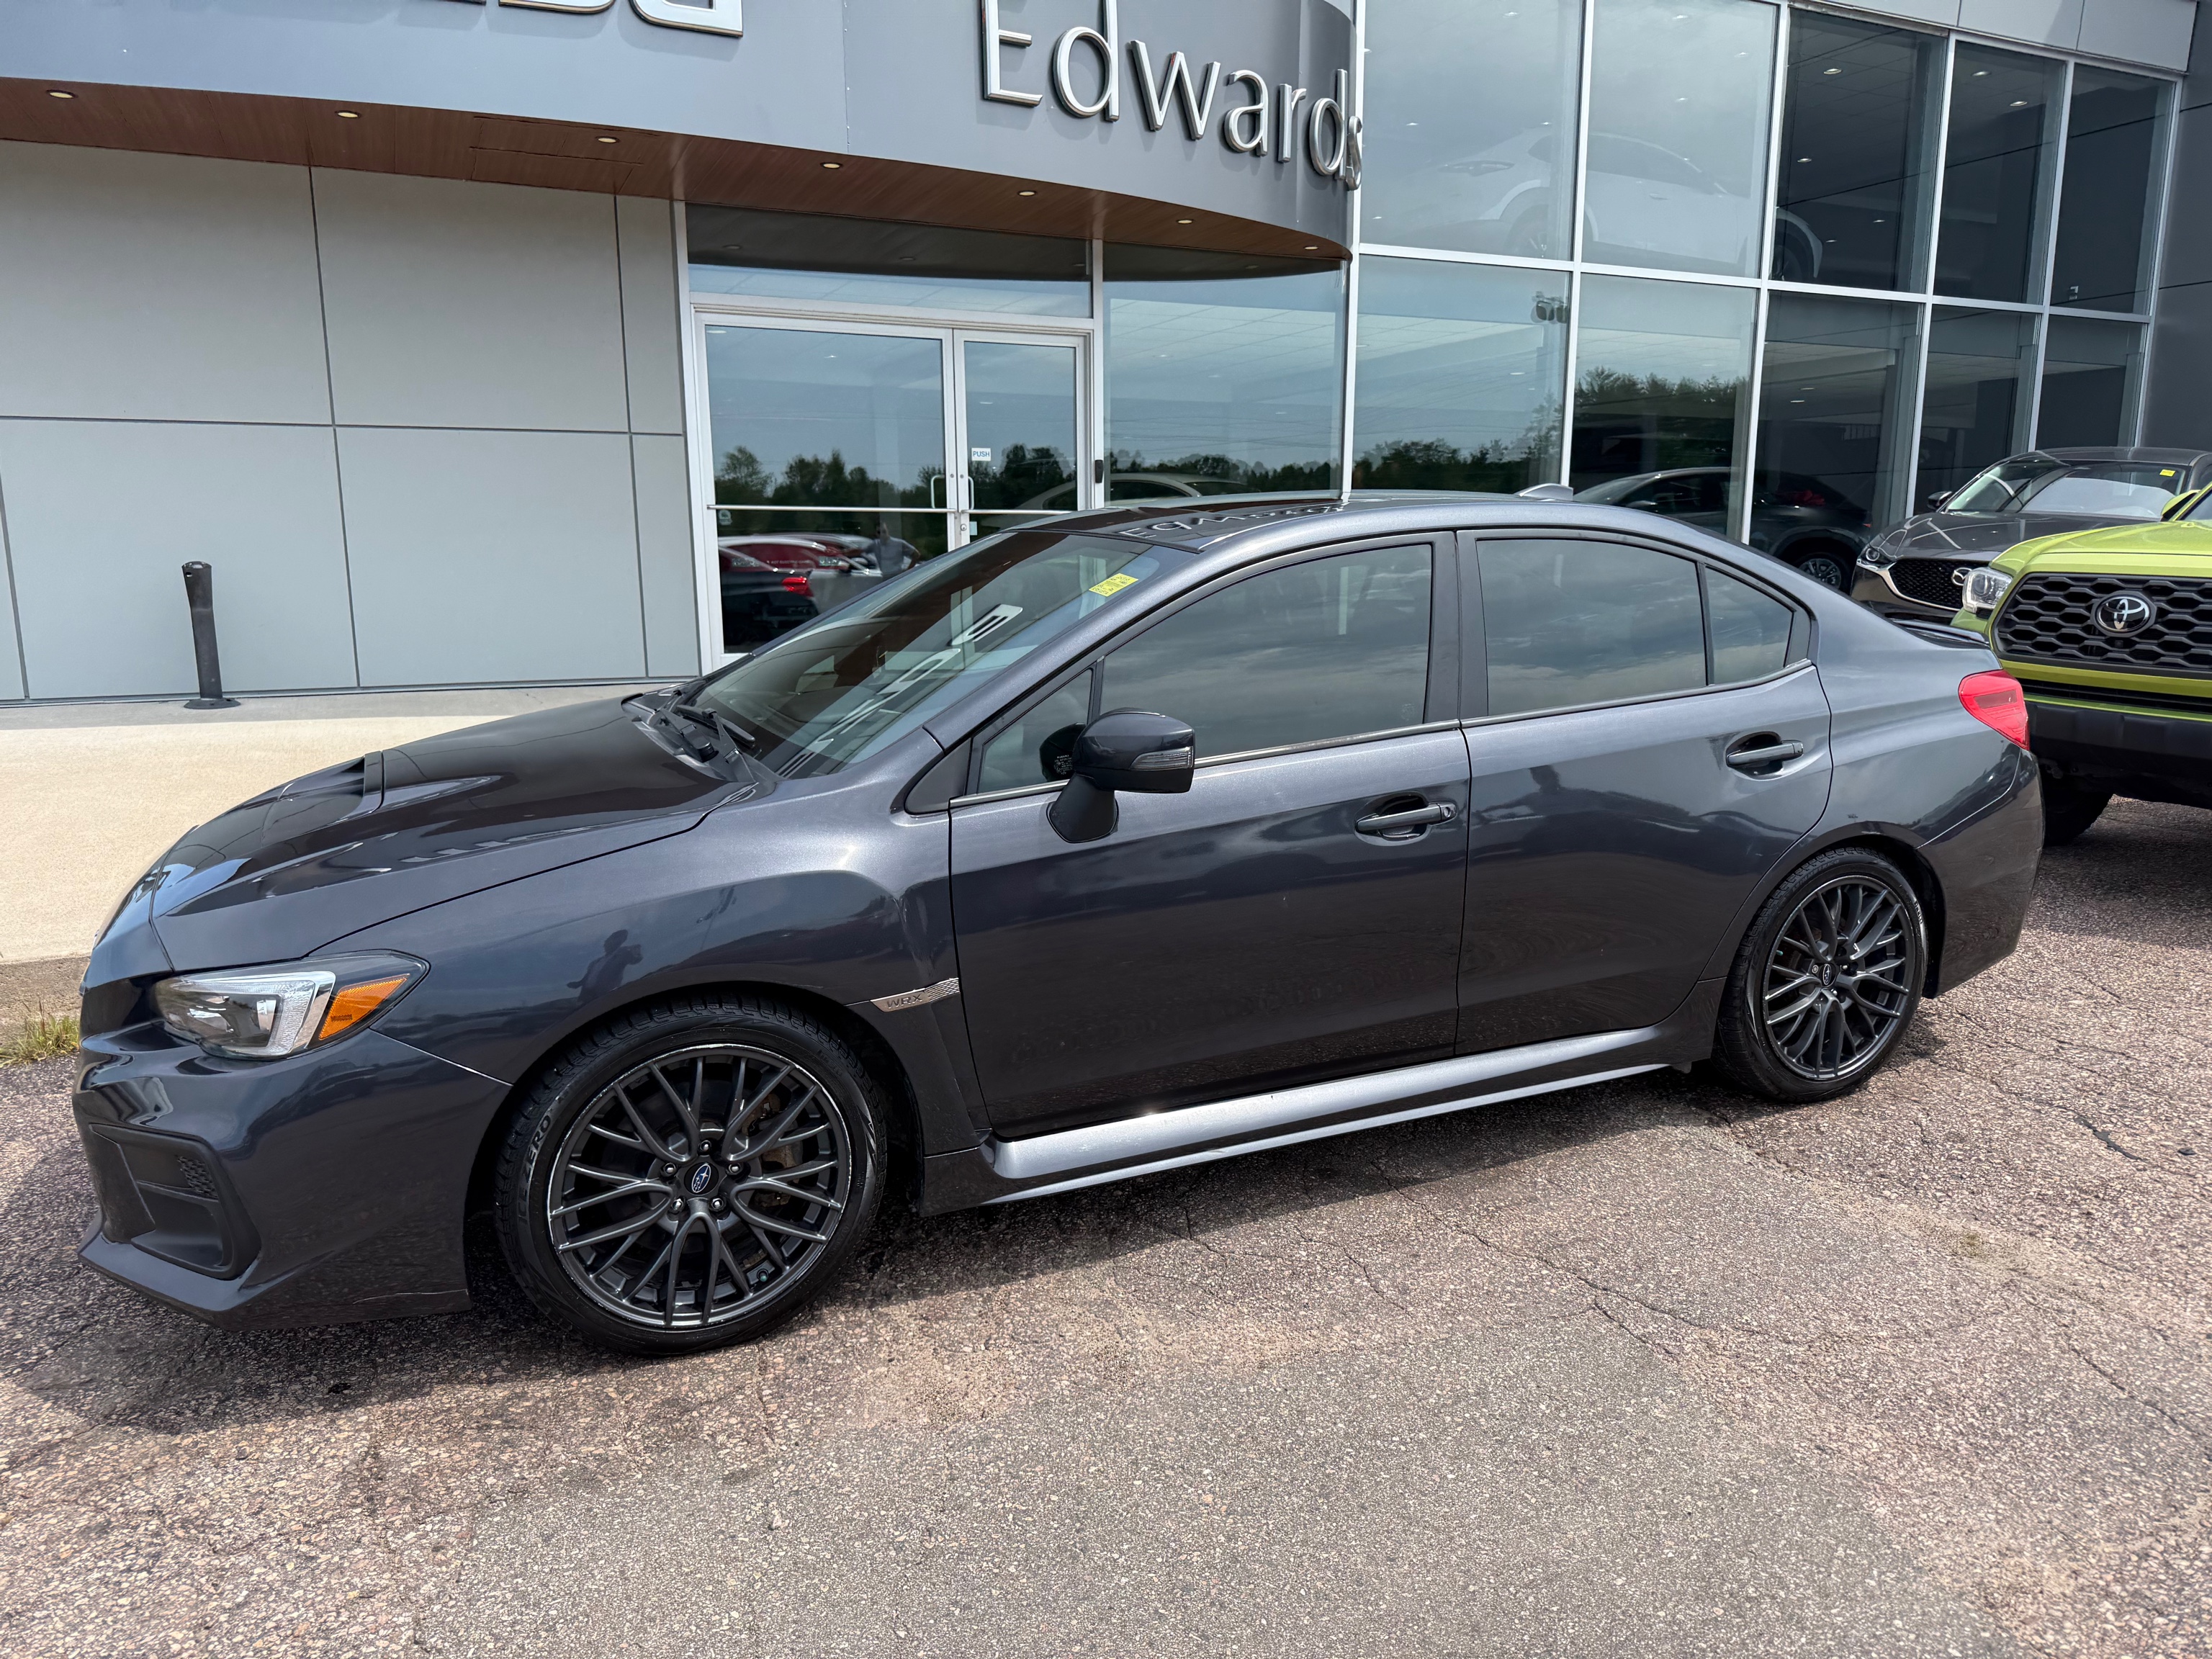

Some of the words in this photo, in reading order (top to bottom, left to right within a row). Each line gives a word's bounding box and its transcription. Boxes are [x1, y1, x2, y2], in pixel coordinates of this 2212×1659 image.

[981, 0, 1363, 191] Edwards
[886, 994, 923, 1009] WRX
[522, 1115, 552, 1183] ZERO
